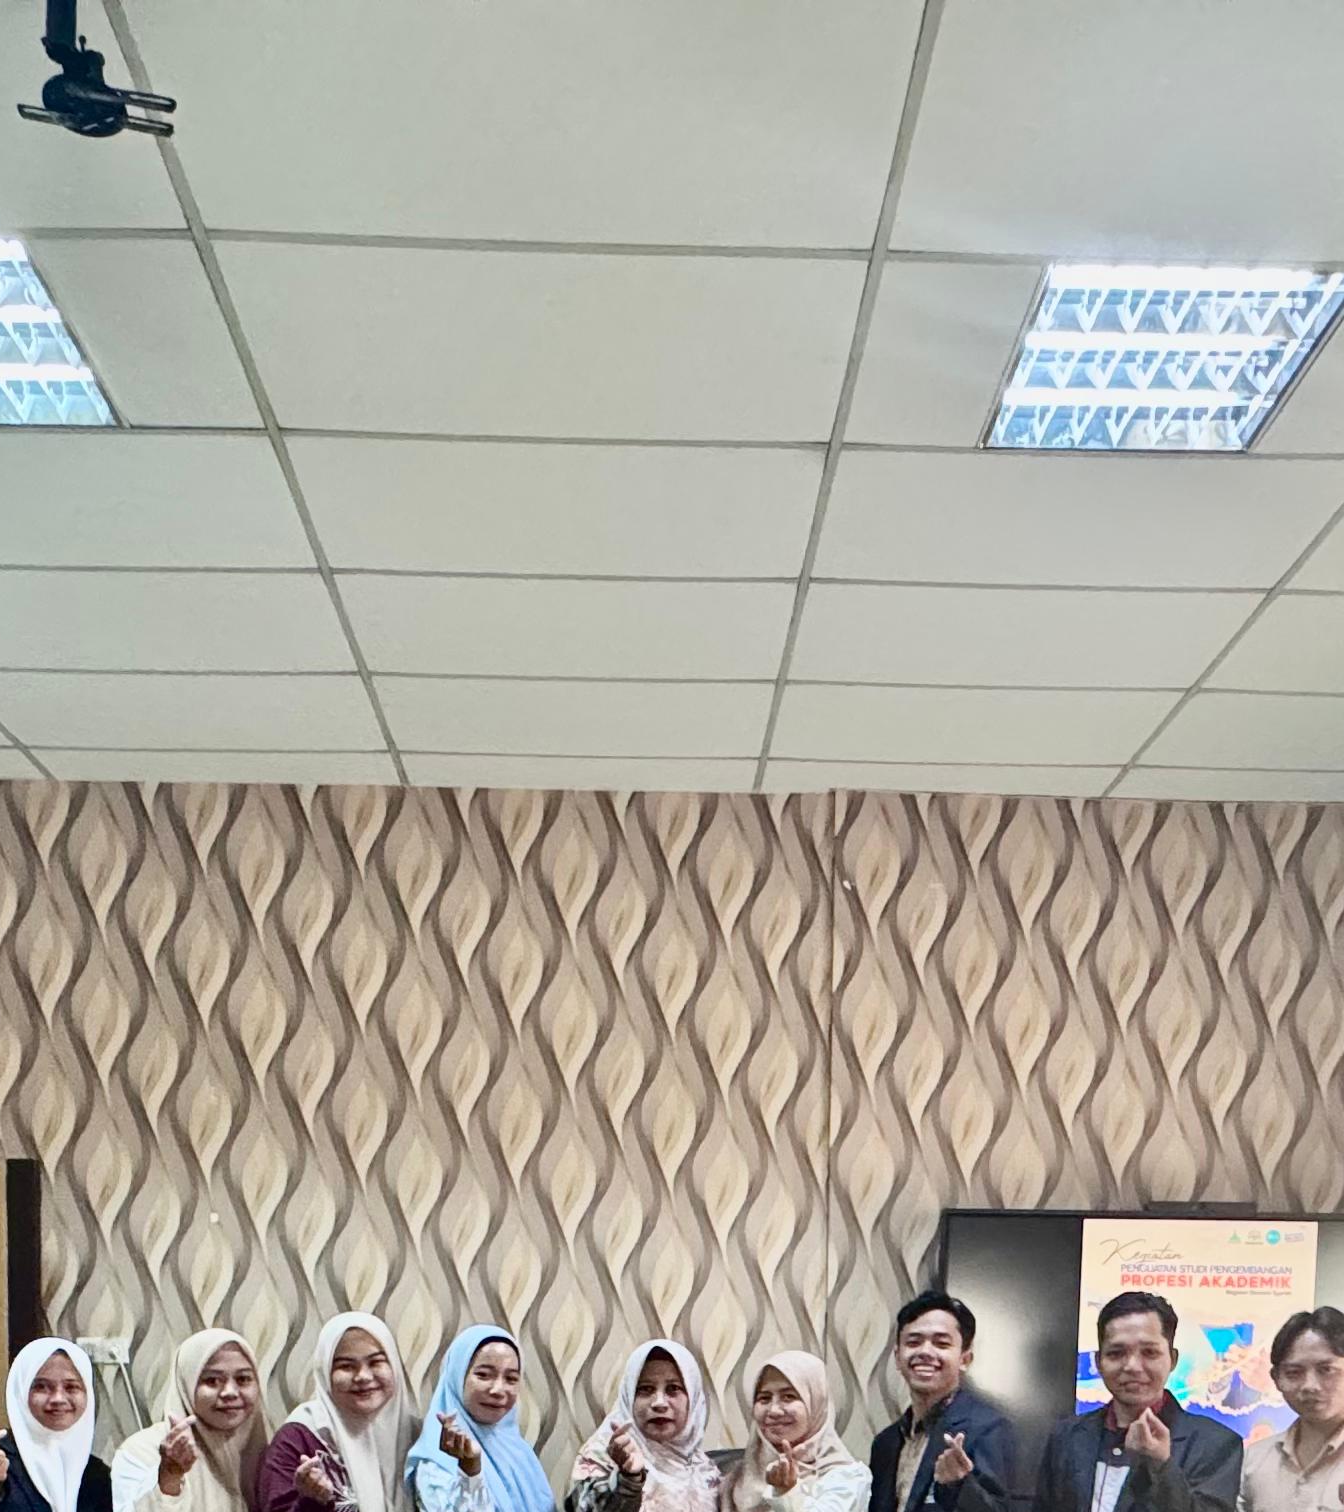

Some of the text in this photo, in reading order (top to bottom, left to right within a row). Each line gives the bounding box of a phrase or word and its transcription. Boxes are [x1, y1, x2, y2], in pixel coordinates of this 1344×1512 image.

[1099, 1238, 1184, 1264] Kegiatan
[1120, 1264, 1292, 1275] PENGUATAN STUDI PENGEMBANGAN
[1120, 1274, 1292, 1289] PROFESI AKADEMIK
